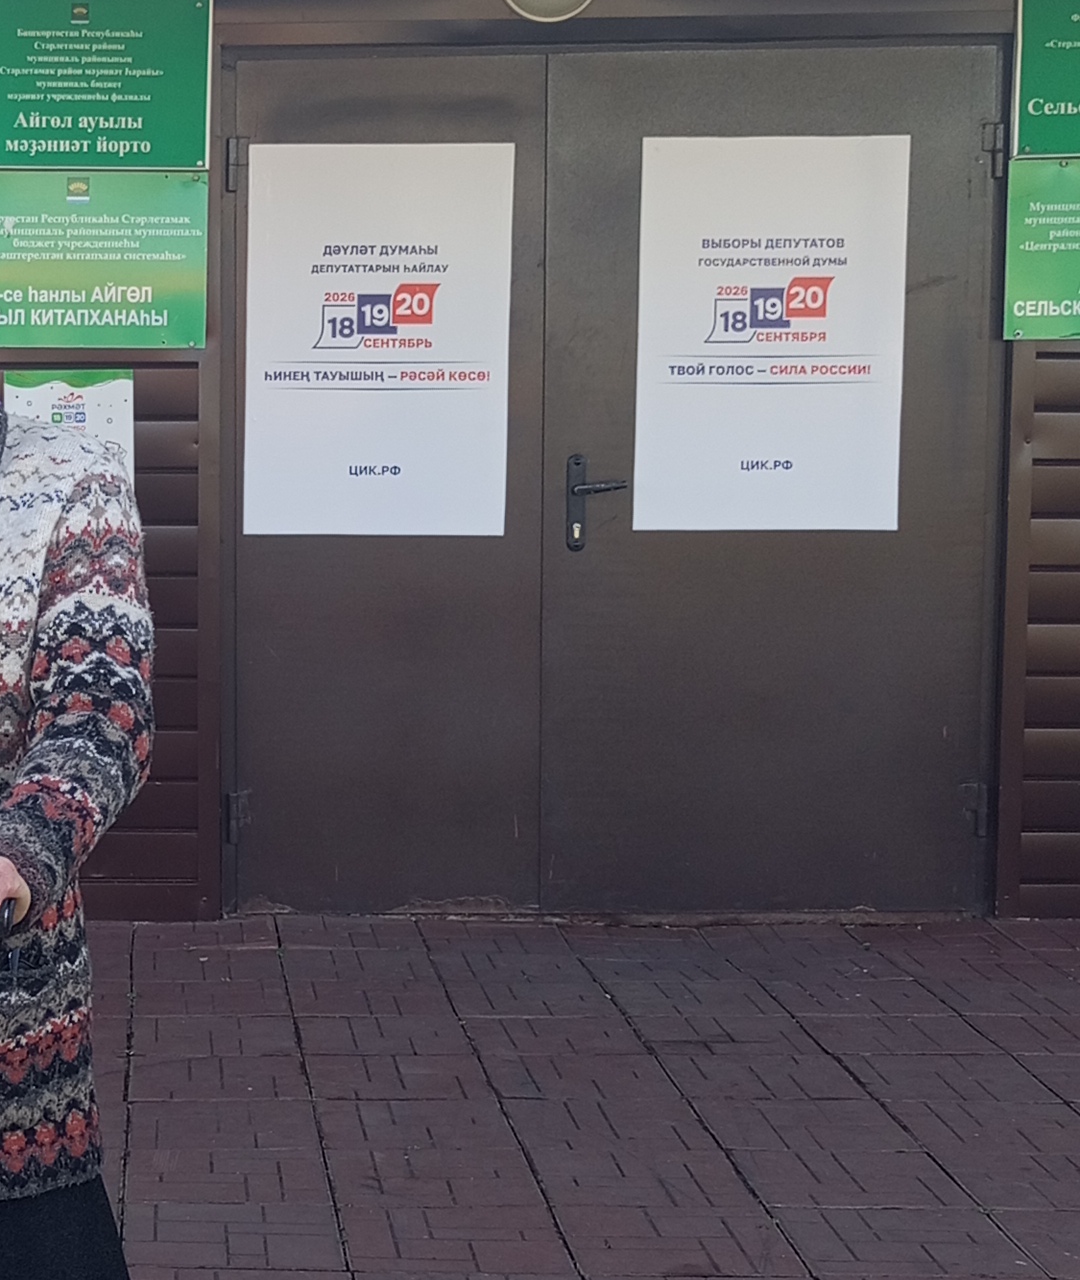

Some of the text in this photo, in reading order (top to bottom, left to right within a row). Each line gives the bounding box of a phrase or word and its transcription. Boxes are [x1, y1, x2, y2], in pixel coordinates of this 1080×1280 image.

[1028, 98, 1080, 116] Сель
[13, 112, 143, 132] Айгөл ауылы
[96, 136, 151, 157] йорто
[12, 238, 55, 249] бюджет
[701, 238, 845, 250] ВЫБОРЫ ДЕПУТАТОВ
[66, 252, 121, 262] китапхана
[322, 245, 377, 257] ДӘҮЛӘТ
[698, 256, 848, 268] ГОСУДАРСТВЕННОЙ ДУМЫ
[311, 264, 400, 275] ДЕПУТАТТАРЫН
[90, 282, 152, 303] АЙГӨЛ
[324, 292, 355, 302] 2026
[716, 286, 748, 296] 2026
[720, 286, 825, 332] 18 19 20
[327, 293, 431, 338] 18 19 20
[756, 332, 827, 342] СЕНТЯБРЯ
[363, 339, 432, 349] СЕНТЯБРЬ
[314, 371, 385, 383] ТАУЫШЫҢ
[400, 369, 445, 382] РӘСӘЙ
[448, 371, 490, 382] КӨСӨ!
[669, 364, 705, 376] ТВОЙ
[708, 365, 754, 376] ГОЛОС
[770, 365, 807, 375] СИЛА
[811, 365, 871, 375] РОССИИ!
[349, 465, 401, 477] ЦИК.РФ
[740, 460, 793, 471] ЦИК.РФ
